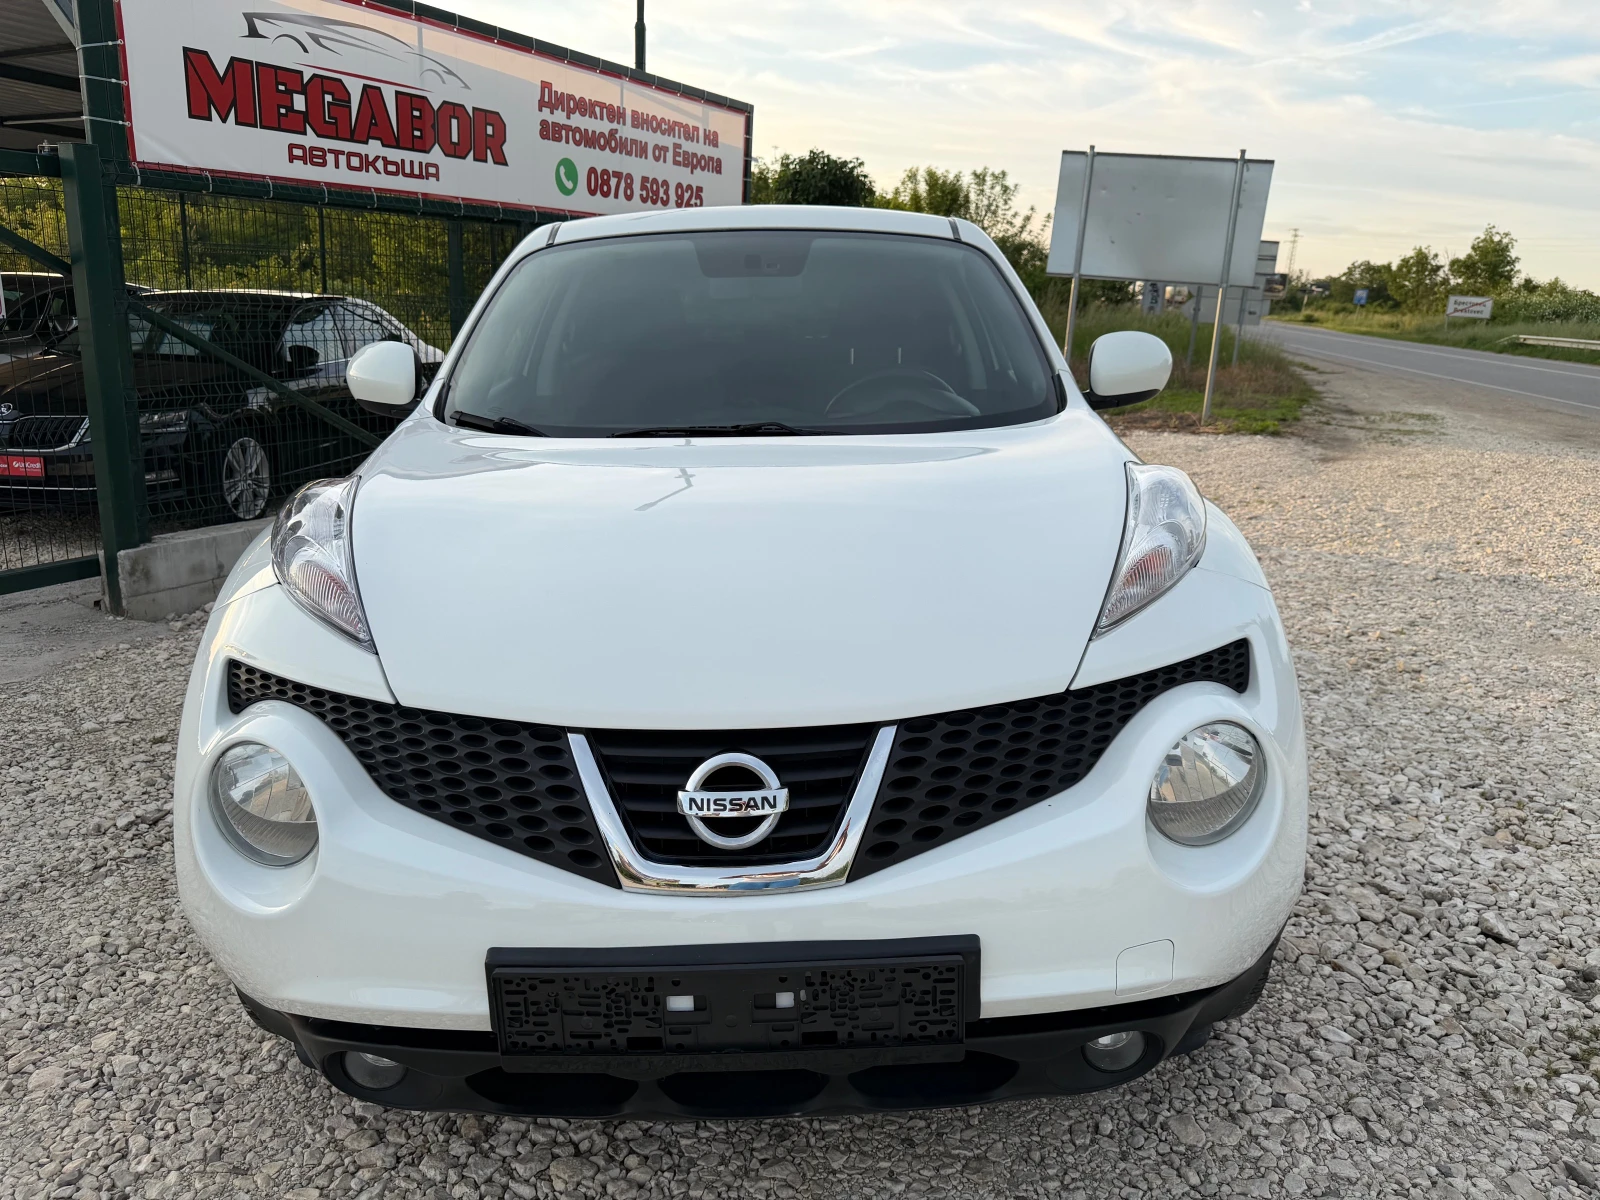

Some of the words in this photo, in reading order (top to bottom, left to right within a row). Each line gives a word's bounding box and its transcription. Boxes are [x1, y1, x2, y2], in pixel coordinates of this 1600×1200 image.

[182, 46, 508, 166] MEGABOR
[538, 80, 626, 126] Директен
[631, 109, 699, 143] вносител
[703, 128, 719, 148] на
[539, 119, 648, 160] автомобили
[652, 144, 669, 163] от
[672, 143, 722, 175] Европа
[586, 166, 634, 202] 0878
[639, 176, 670, 207] 593
[674, 182, 704, 209] 925
[688, 795, 777, 812] NISSAN
